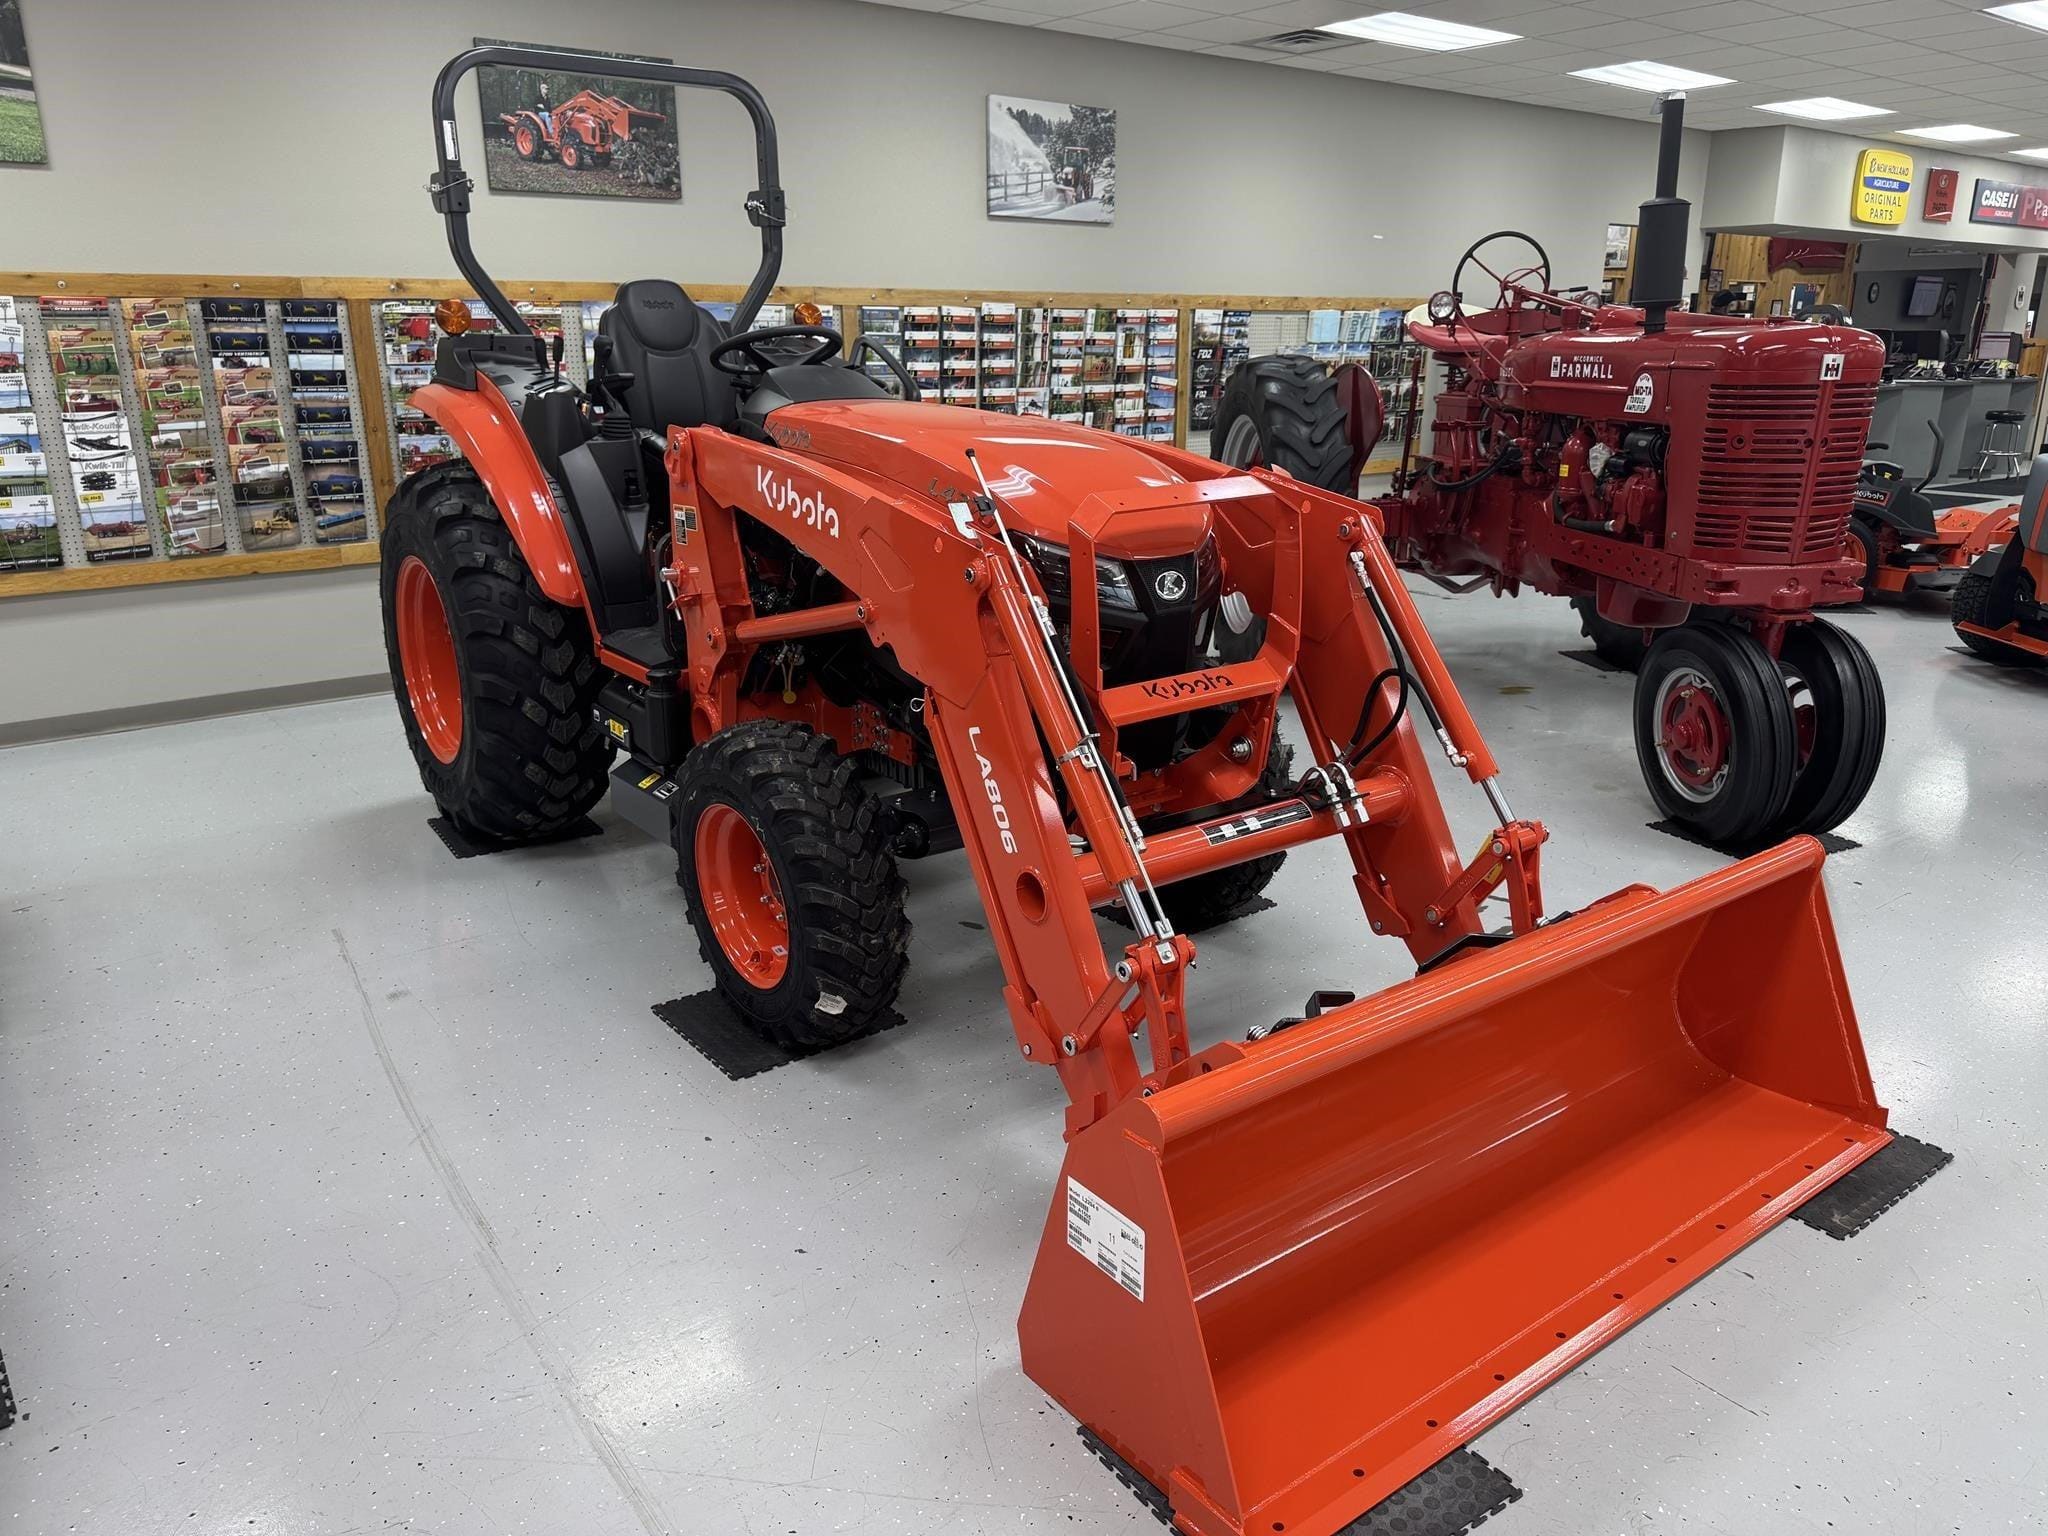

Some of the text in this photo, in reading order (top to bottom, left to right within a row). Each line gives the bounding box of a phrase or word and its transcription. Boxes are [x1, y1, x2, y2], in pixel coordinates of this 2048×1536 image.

[1876, 163, 1909, 177] NEW HOLLAND
[1864, 192, 1902, 207] ORIGINAL
[1870, 207, 1894, 221] PARTS
[1561, 363, 1614, 379] FARMALL
[1634, 385, 1652, 396] MD-TA
[84, 460, 127, 471] Kwik-Till
[757, 464, 839, 539] Kubota
[1142, 672, 1234, 700] Kubota
[968, 726, 1018, 854] LA806
